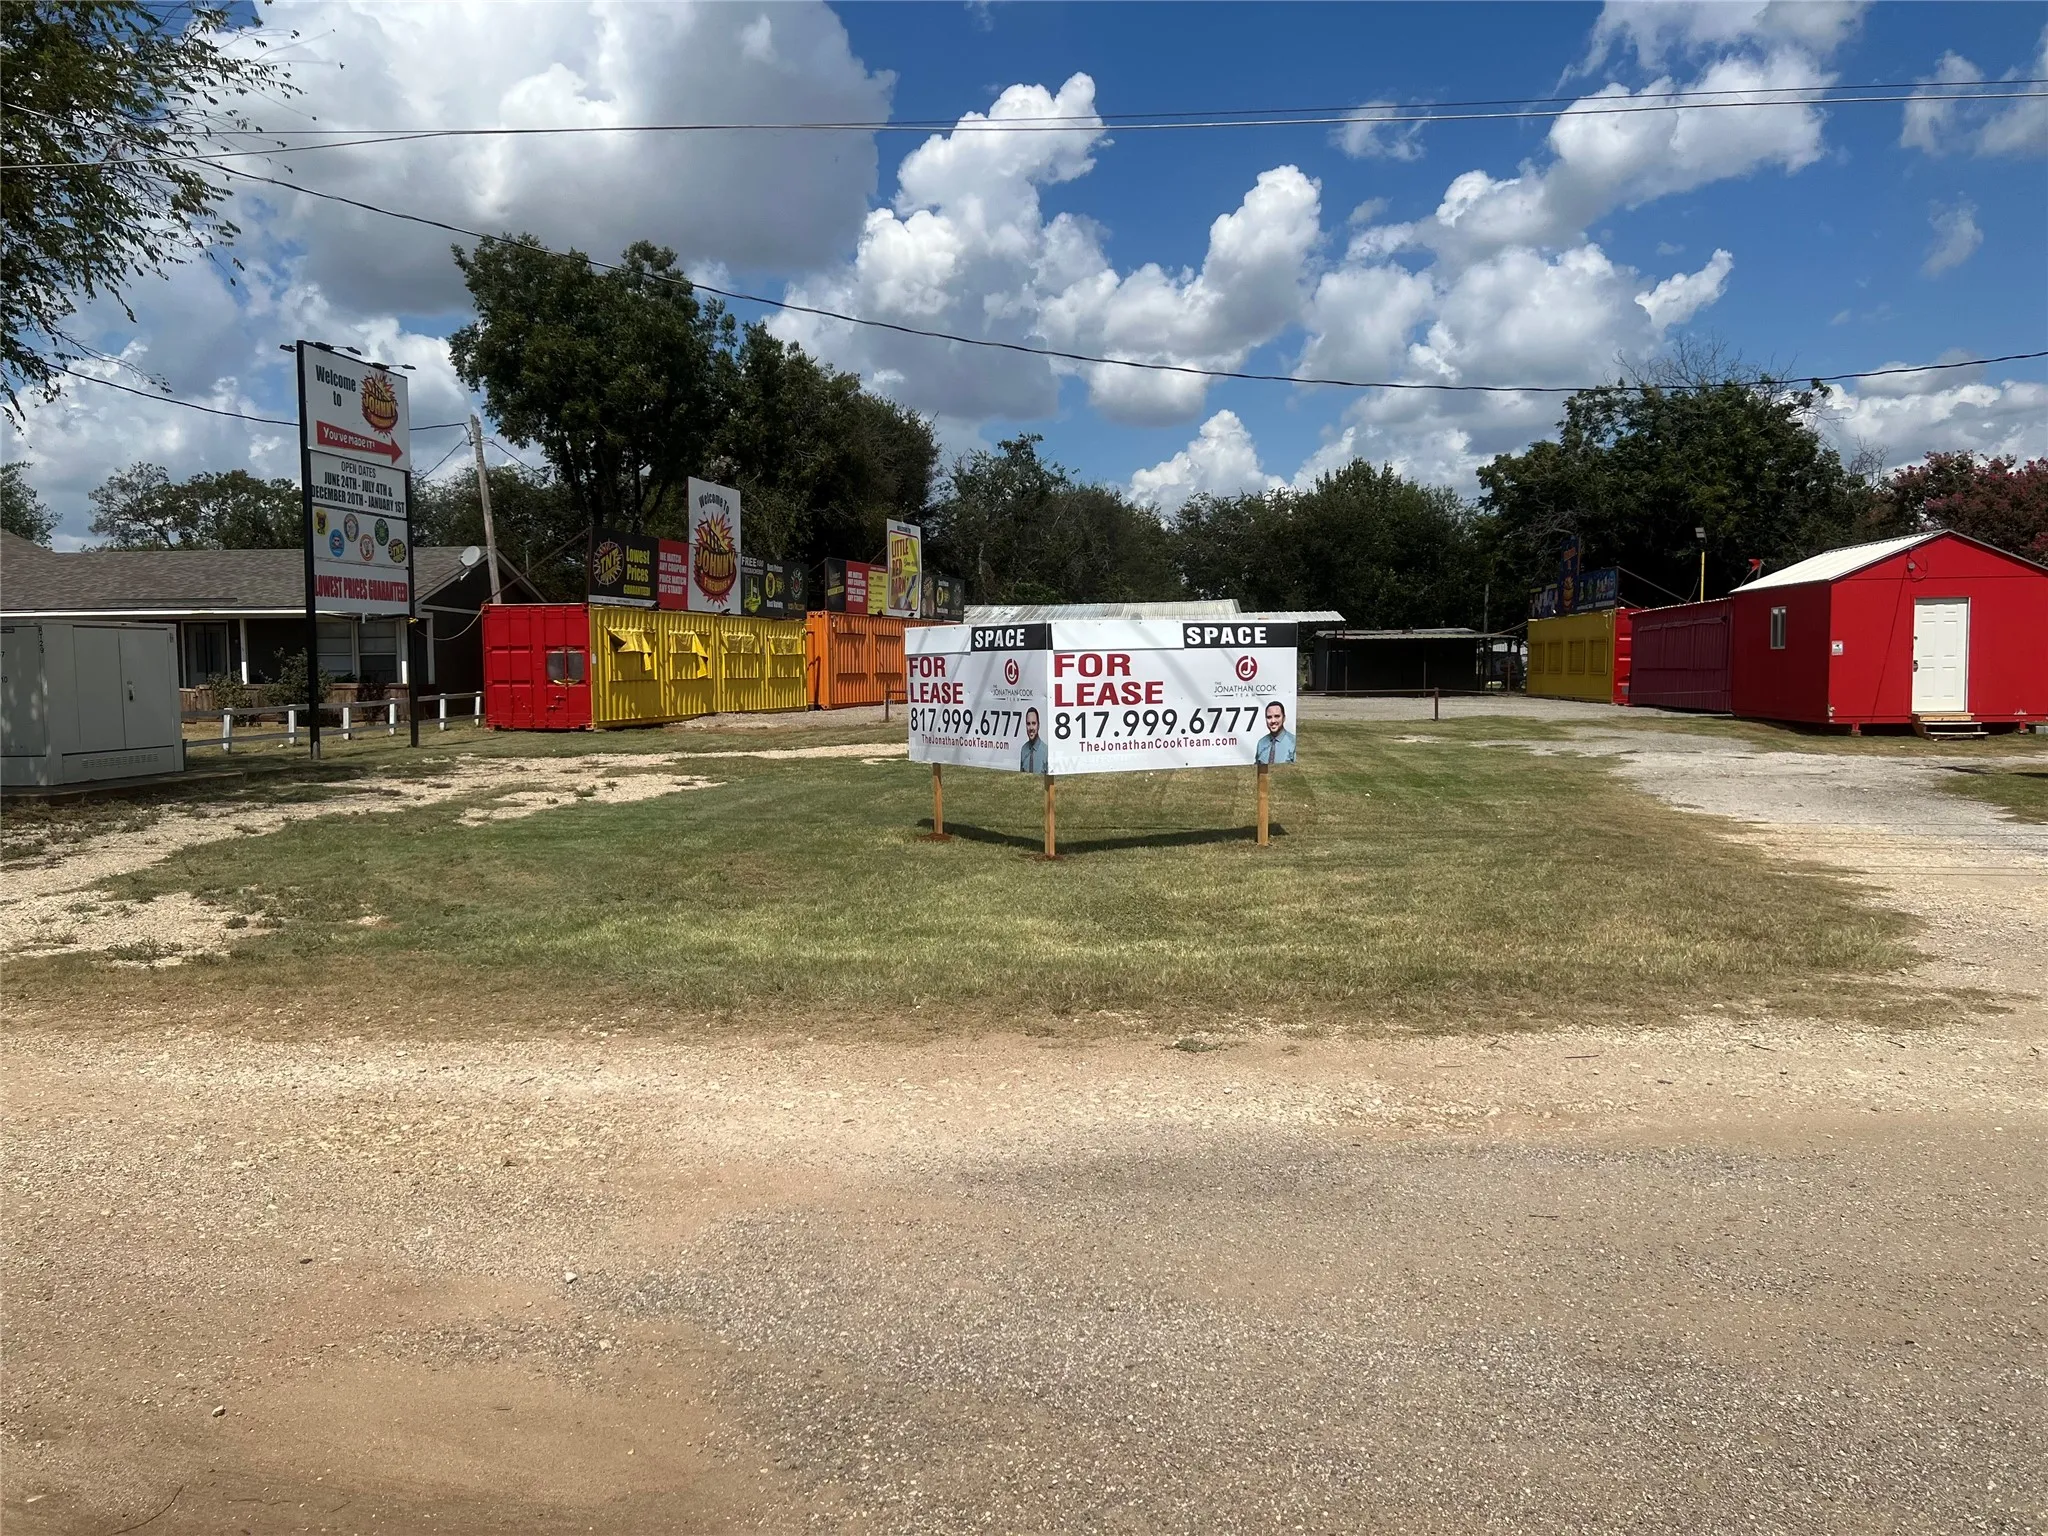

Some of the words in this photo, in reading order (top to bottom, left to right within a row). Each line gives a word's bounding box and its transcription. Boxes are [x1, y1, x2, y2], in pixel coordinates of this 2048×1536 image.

[316, 364, 357, 393] Welcome
[333, 390, 342, 407] to
[323, 426, 348, 443] You've
[341, 461, 357, 475] OPEN
[358, 465, 376, 479] DATES
[324, 471, 340, 488] JUNE
[341, 475, 357, 490] 24TH
[362, 480, 375, 494] JULY
[376, 483, 387, 497] 4TH
[311, 484, 346, 503] DECEMBER
[347, 491, 364, 506] 20TH
[368, 496, 394, 512] JANUARY
[394, 501, 405, 514] 1ST
[699, 491, 723, 508] Welcome
[626, 545, 650, 564] Lowest
[892, 537, 909, 558] LITTLE
[600, 547, 619, 574] TNT
[696, 546, 735, 577] JOHNNY
[741, 556, 757, 567] FREE
[892, 558, 903, 577] RED
[627, 563, 649, 583] Prices
[315, 574, 342, 599] LOWEST
[344, 577, 368, 600] PRICES
[974, 628, 1025, 649] SPACE
[1186, 626, 1267, 645] SPACE
[909, 656, 946, 678] FOR
[1053, 653, 1132, 678] FOR
[909, 682, 964, 705] LEASE
[1054, 681, 1164, 707] LEASE
[1214, 685, 1254, 693] JONATHAN
[1255, 684, 1277, 692] COOK
[910, 707, 1023, 738] 817.999.6777
[1054, 706, 1260, 740] 817.999.6777
[921, 733, 1010, 750] TheJonathanCookTeam.com
[1079, 736, 1238, 752] TheJonathanCookTeam.com
